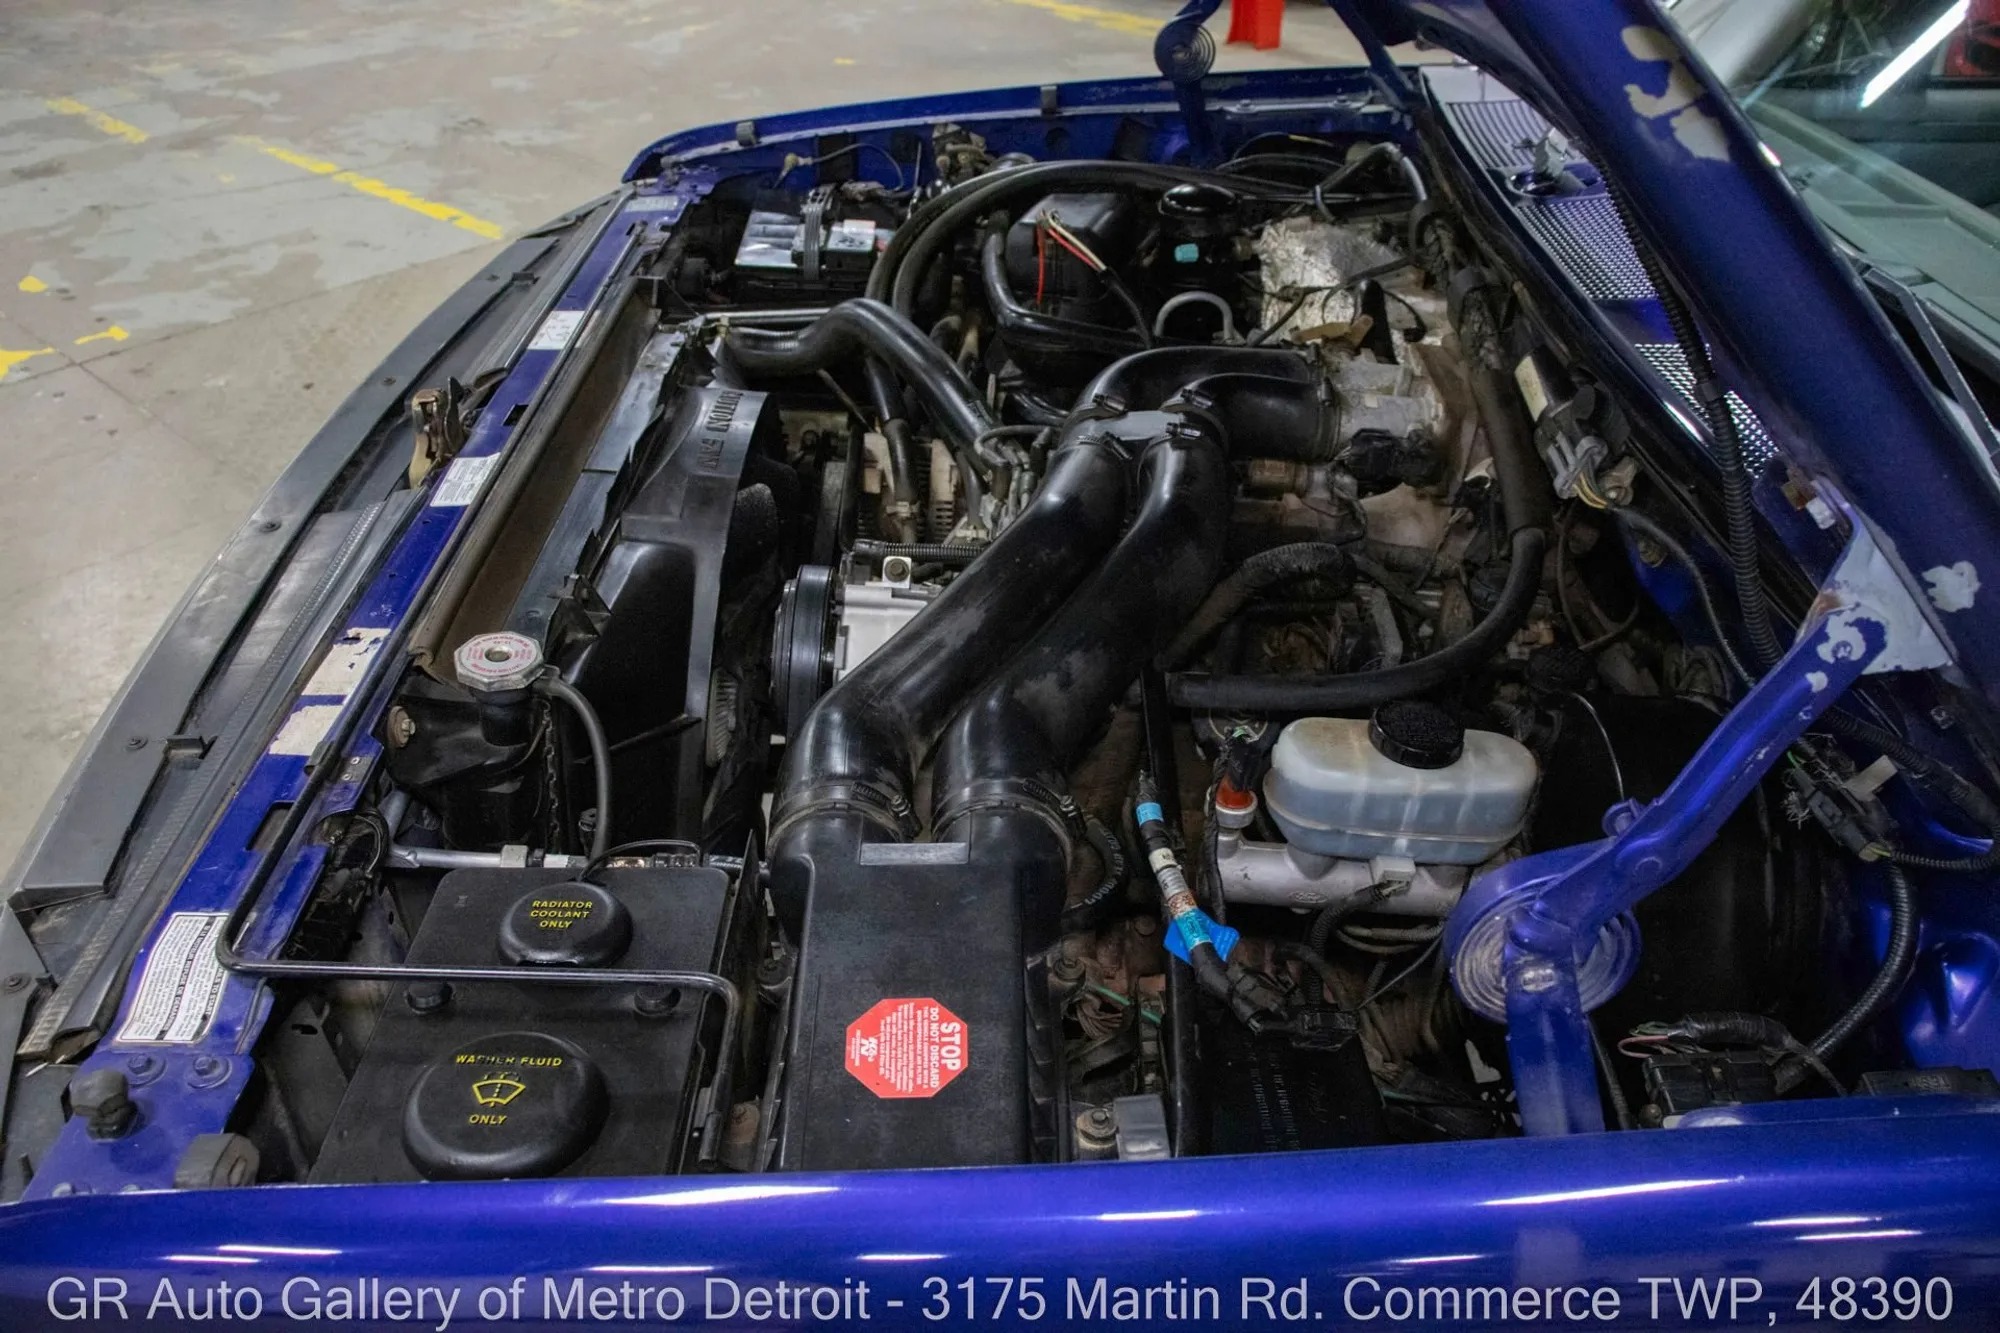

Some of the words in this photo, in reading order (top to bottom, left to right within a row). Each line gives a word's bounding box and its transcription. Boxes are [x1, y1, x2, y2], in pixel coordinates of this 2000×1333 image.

[532, 900, 593, 909] RADIATOR
[530, 910, 590, 919] COOLANT
[539, 920, 573, 929] ONLY
[205, 994, 217, 1015] START
[929, 1007, 941, 1021] DO
[929, 1023, 940, 1043] NOT
[940, 1022, 962, 1071] STOP
[520, 1056, 563, 1067] FLUID
[929, 1045, 941, 1089] DISCARD
[469, 1114, 508, 1125] ONLY
